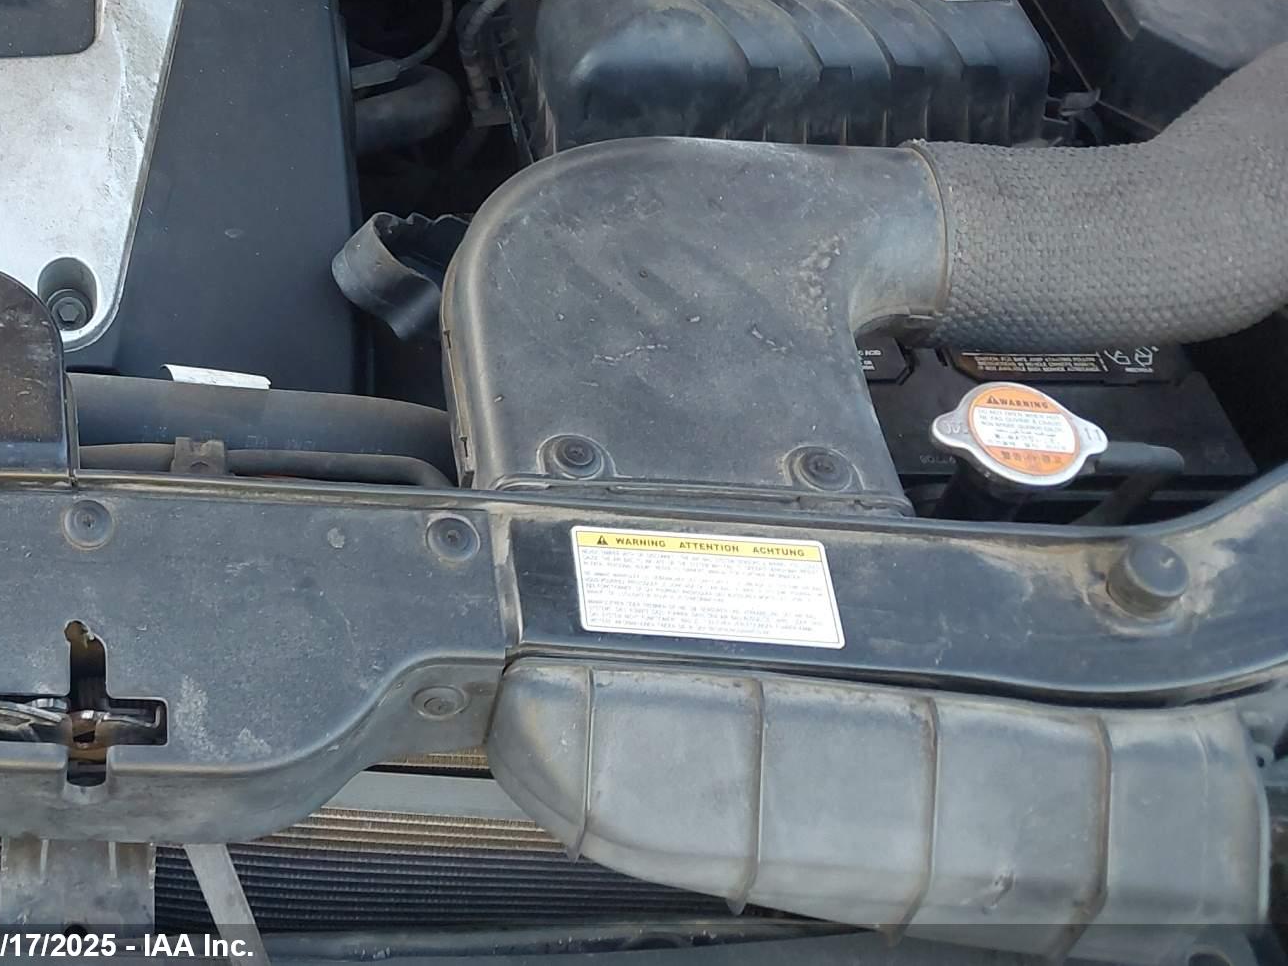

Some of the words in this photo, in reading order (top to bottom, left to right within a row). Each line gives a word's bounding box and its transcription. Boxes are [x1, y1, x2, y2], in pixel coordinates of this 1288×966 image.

[999, 398, 1049, 409] WARNING
[615, 537, 666, 548] WARNING
[679, 541, 740, 553] ATTENTION
[752, 546, 805, 557] ACHTUNG
